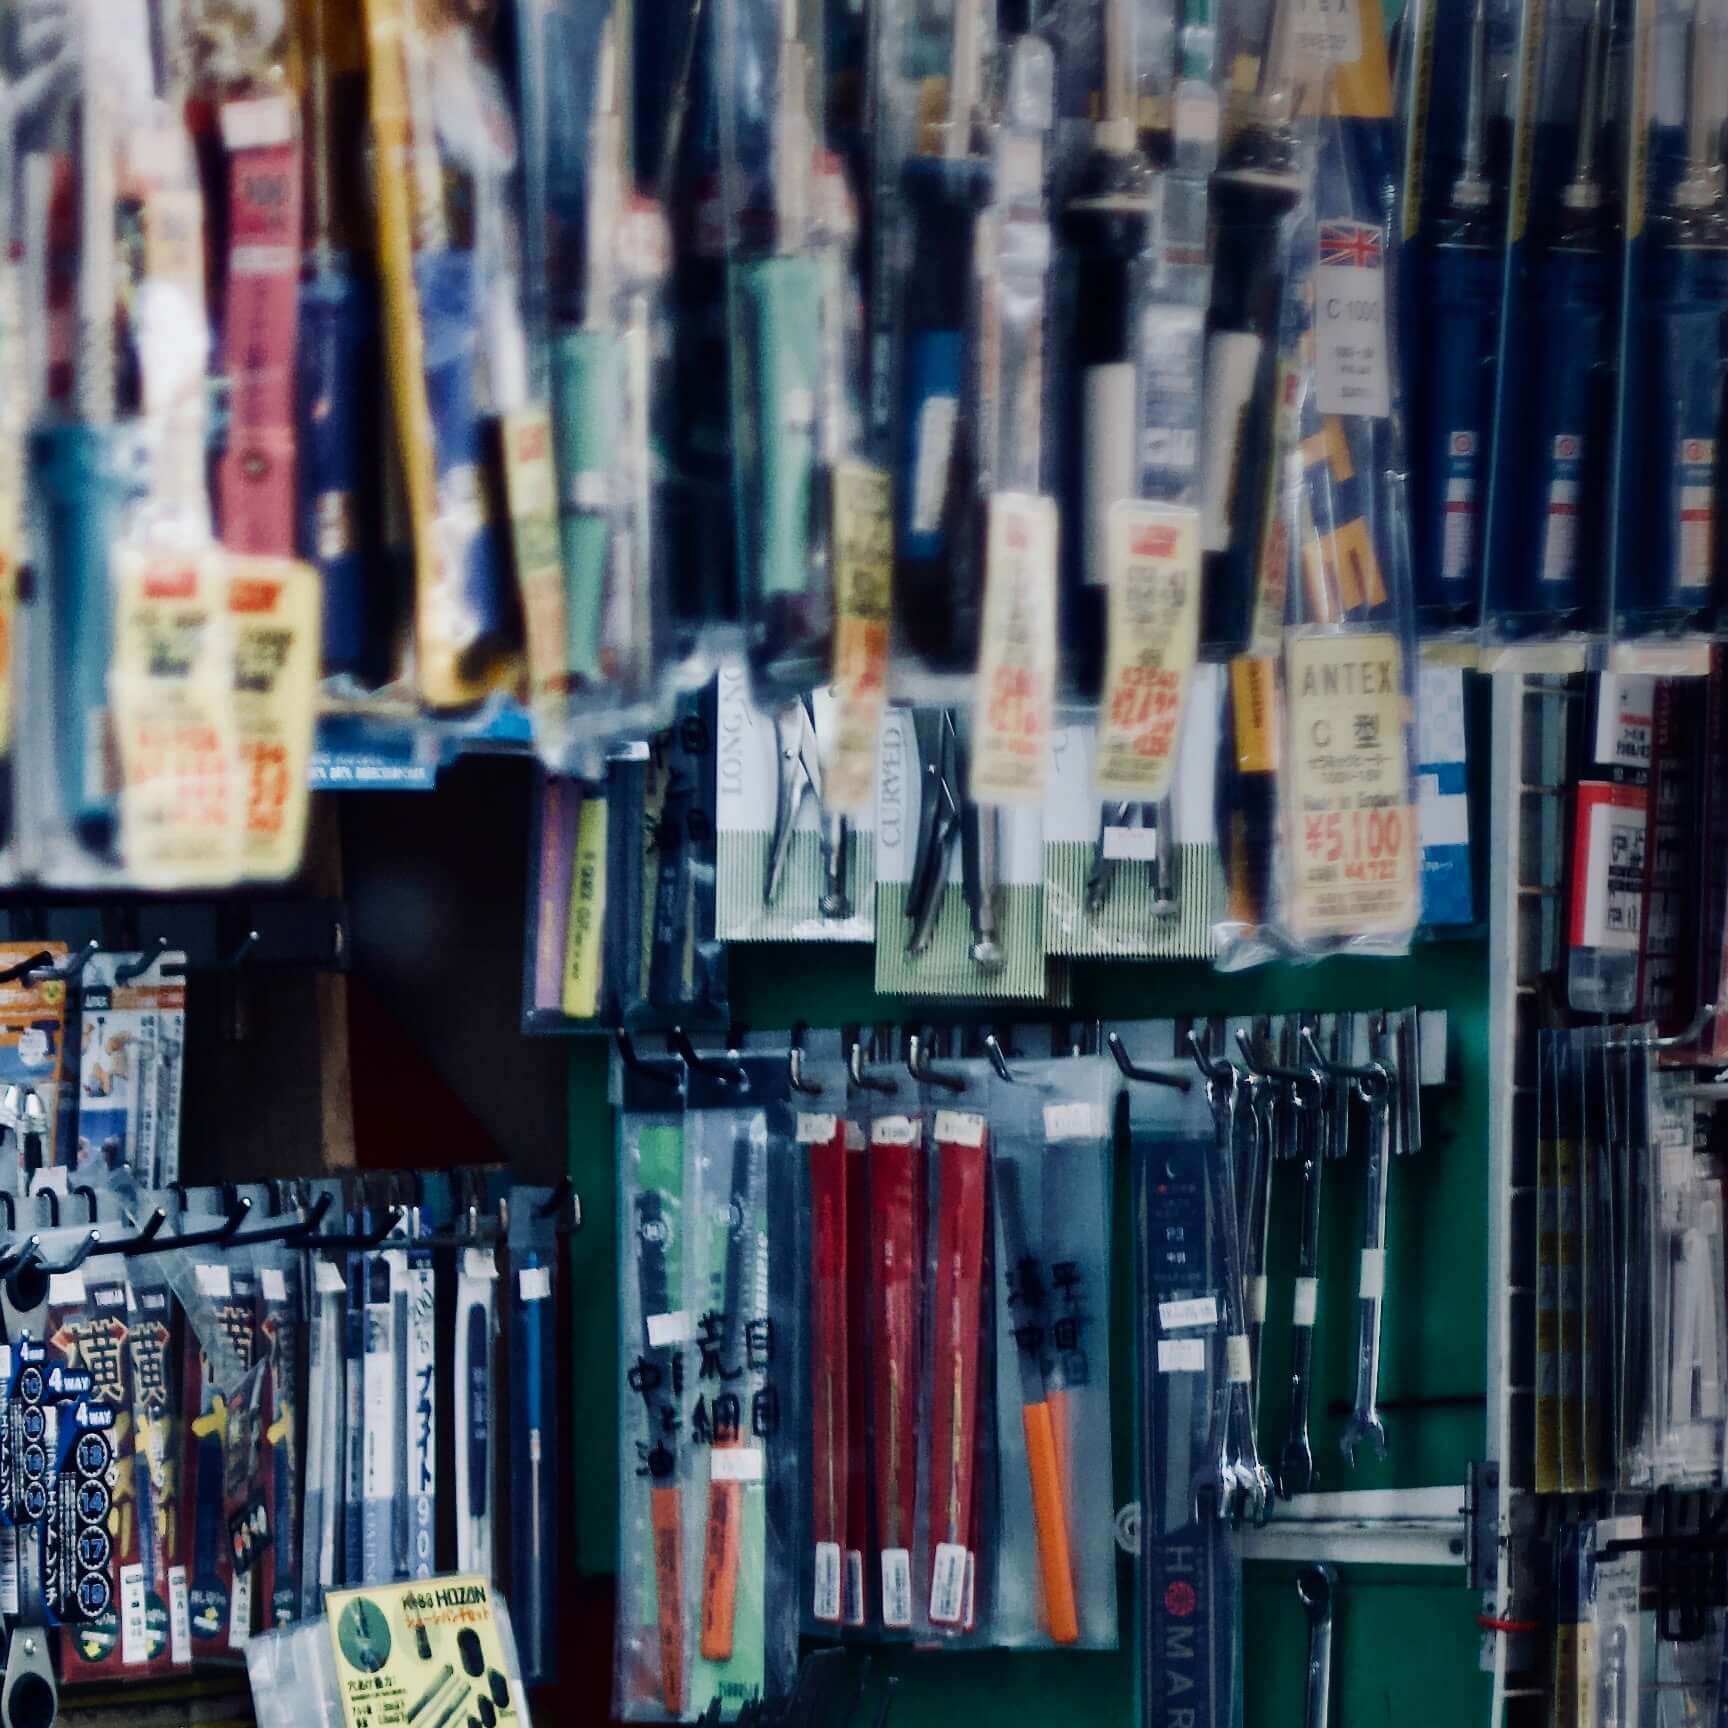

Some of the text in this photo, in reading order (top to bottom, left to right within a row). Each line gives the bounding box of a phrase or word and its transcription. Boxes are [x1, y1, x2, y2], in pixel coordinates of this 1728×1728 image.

[1303, 660, 1394, 697] ANTEX
[62, 1376, 91, 1390] WAY
[75, 1402, 112, 1426] 4 WAY
[434, 1586, 487, 1607] HOZAN
